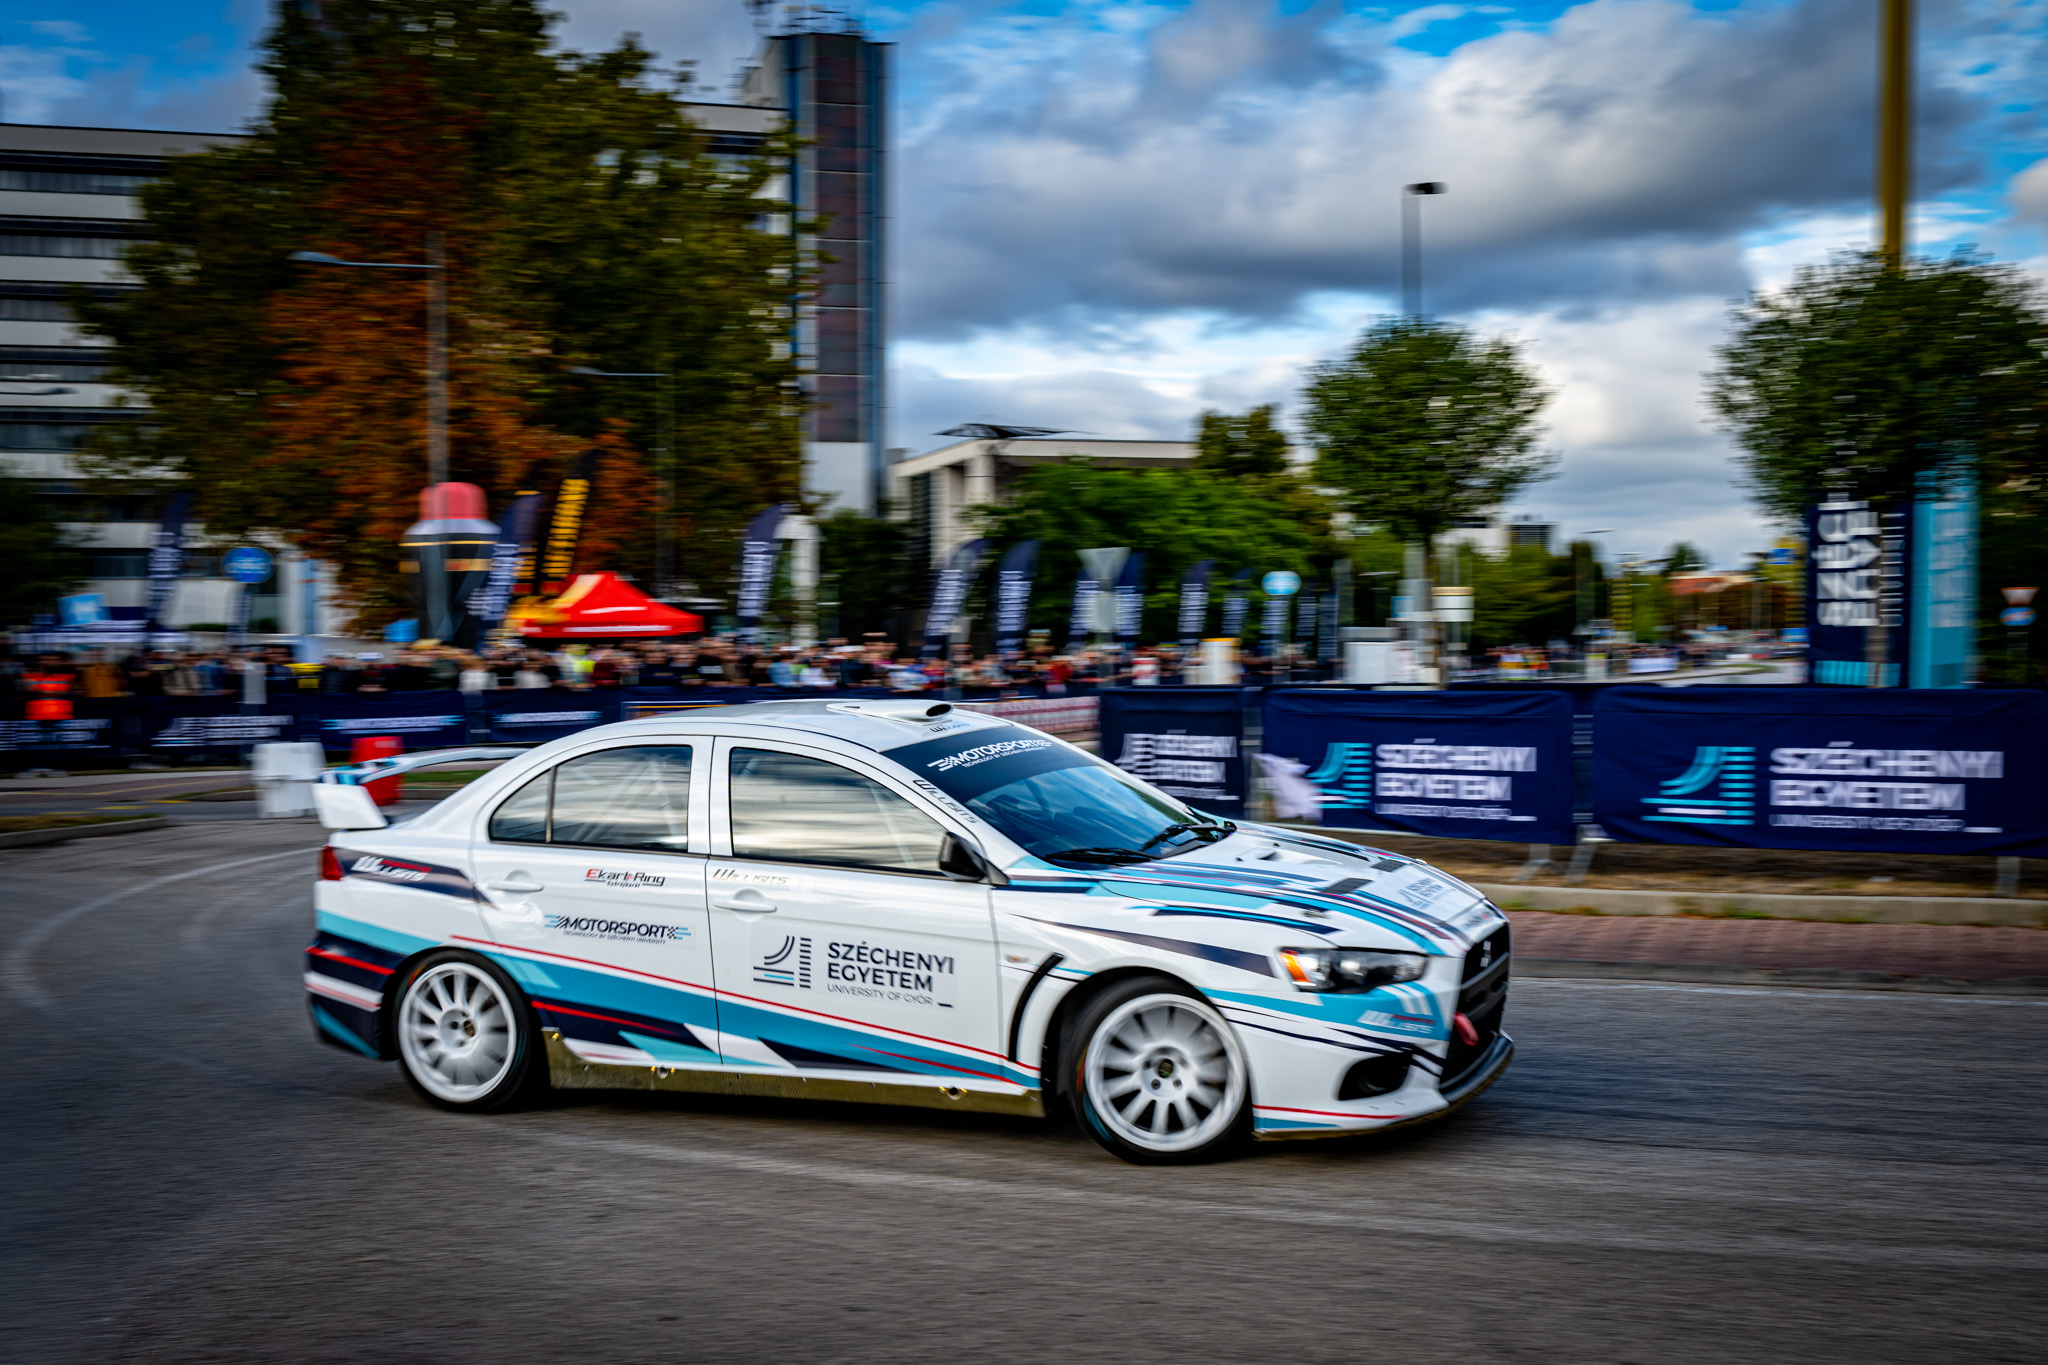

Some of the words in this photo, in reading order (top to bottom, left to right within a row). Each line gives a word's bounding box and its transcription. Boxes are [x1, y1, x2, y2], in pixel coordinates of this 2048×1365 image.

[953, 740, 1038, 765] MOTORSPORT
[562, 916, 669, 938] MOTORSPORT
[828, 940, 954, 975] SZÉCHENYI
[828, 962, 933, 993] EGYETEM
[827, 983, 885, 999] UNIVERSITY
[887, 991, 901, 1001] OF
